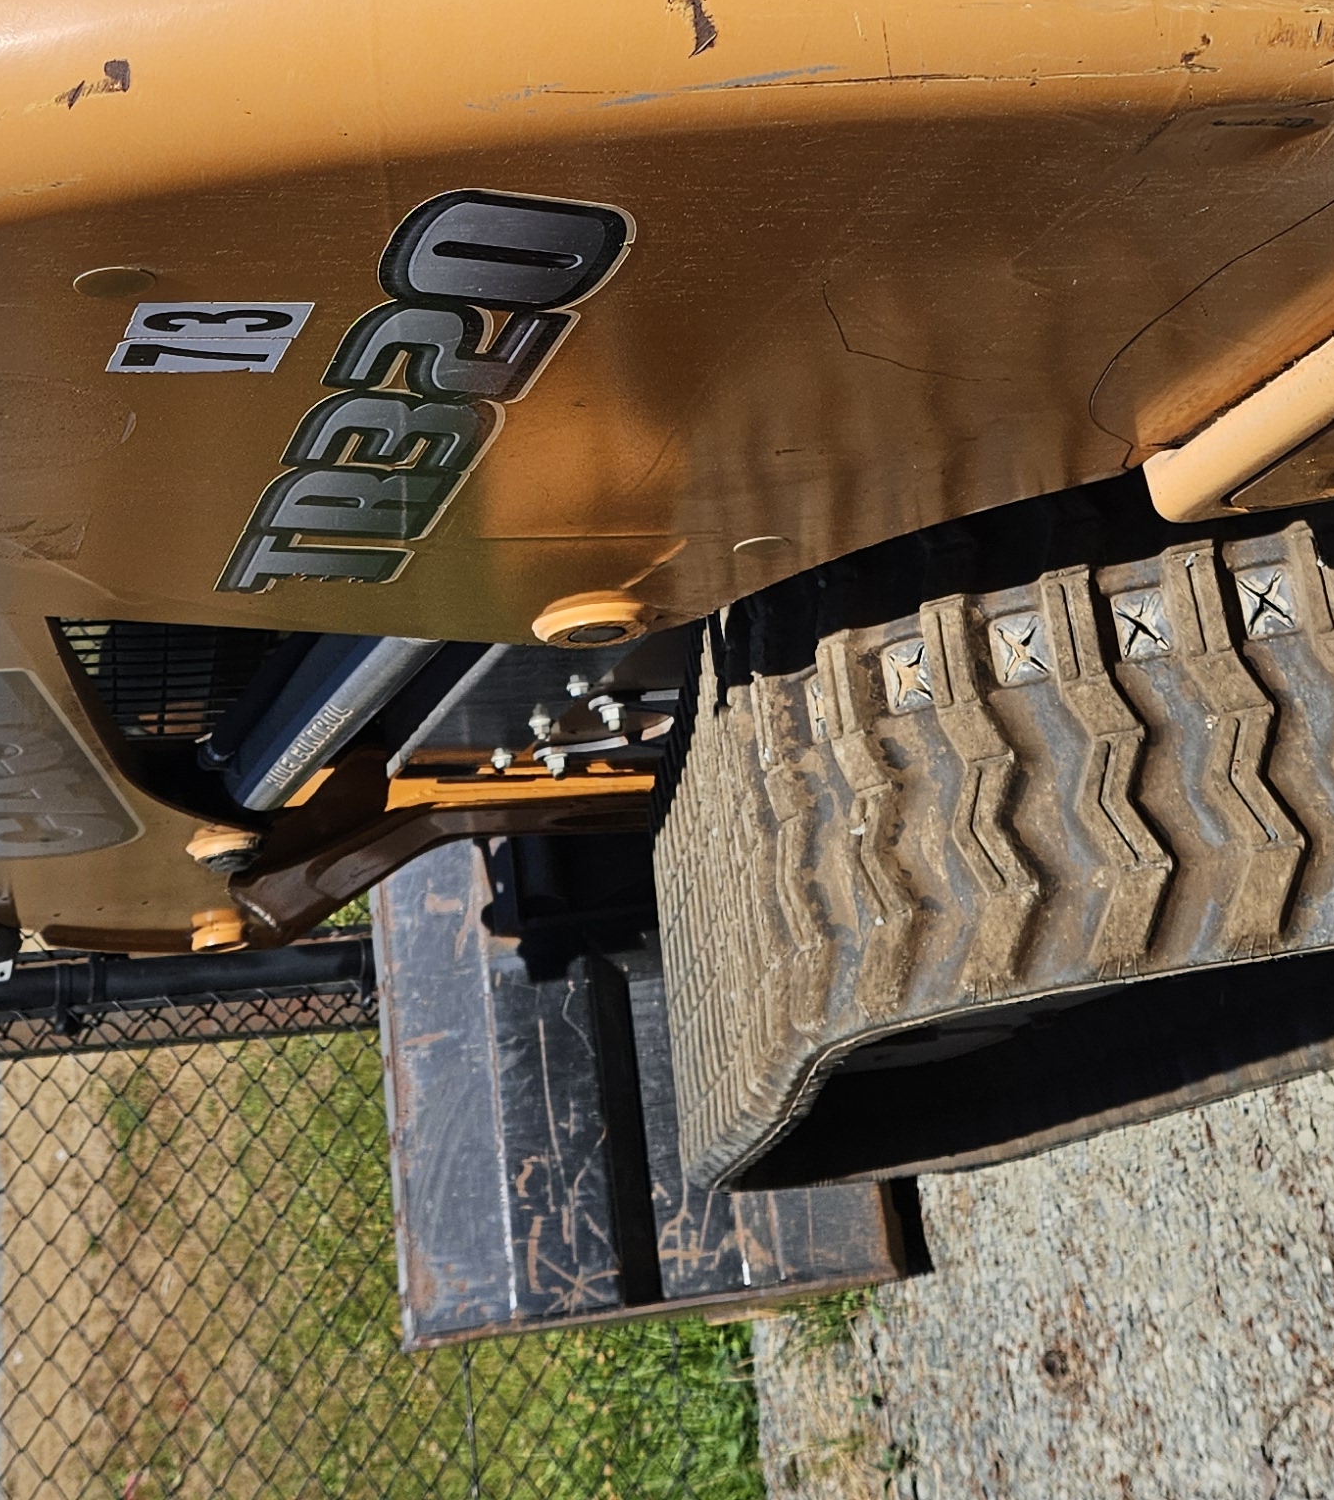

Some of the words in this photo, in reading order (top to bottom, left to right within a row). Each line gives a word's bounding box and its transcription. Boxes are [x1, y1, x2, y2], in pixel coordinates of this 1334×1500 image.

[120, 309, 293, 367] 73
[215, 189, 633, 592] TR320
[265, 756, 303, 790] RIDE
[289, 703, 353, 763] CONTROL
